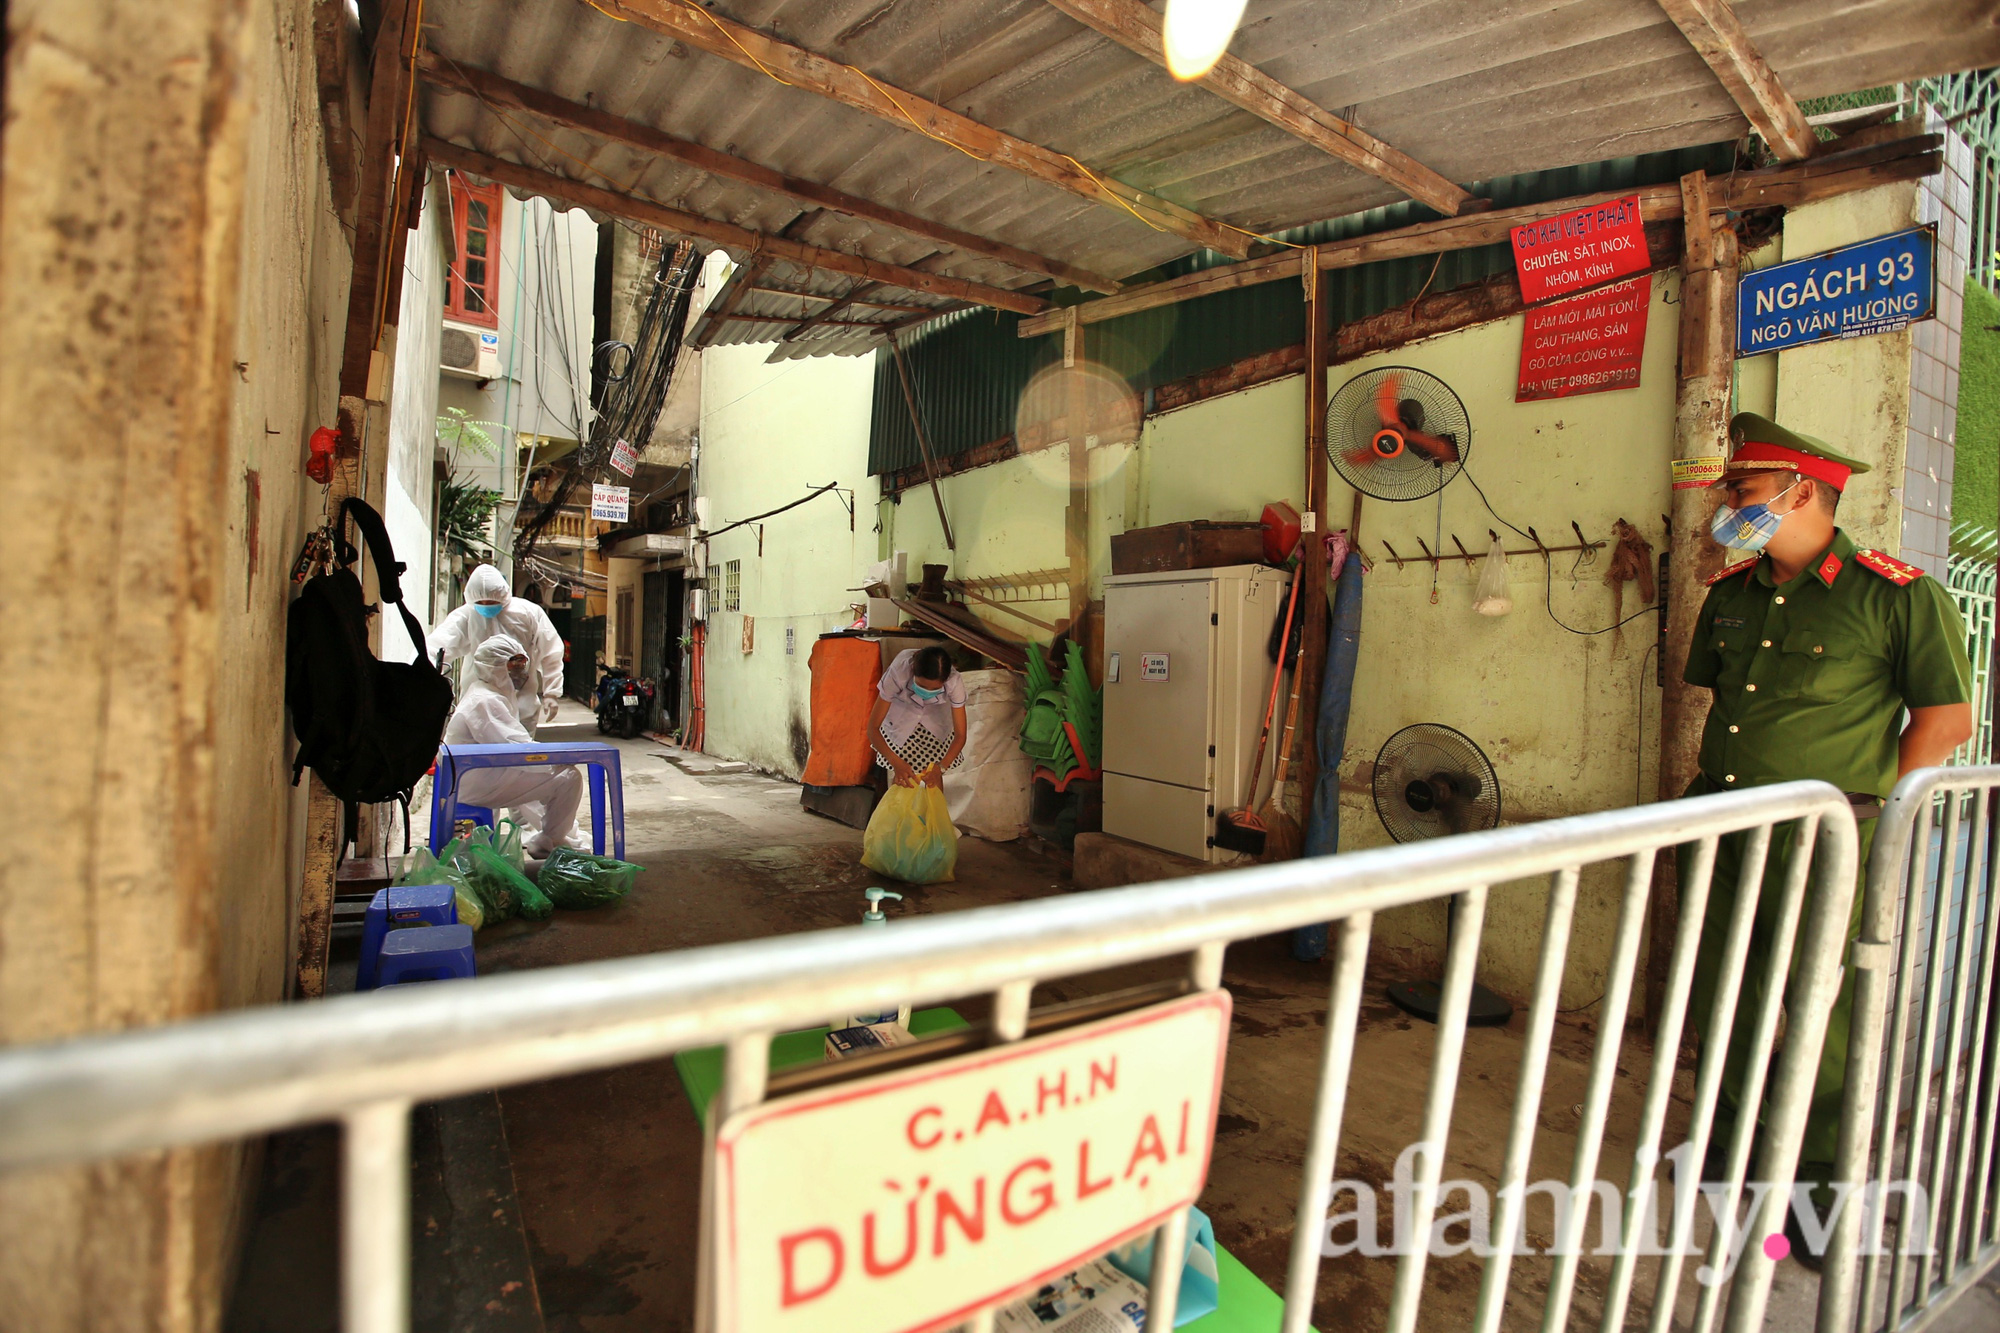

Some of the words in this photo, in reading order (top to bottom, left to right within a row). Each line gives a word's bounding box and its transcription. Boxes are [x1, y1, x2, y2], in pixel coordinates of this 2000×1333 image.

[1517, 226, 1537, 249] CƠ
[1563, 212, 1594, 240] VIỆT
[1523, 249, 1572, 271] CHUYÊN:
[1574, 242, 1599, 260] SẮT,
[1600, 235, 1635, 254] INOX,
[1545, 269, 1583, 287] NHÔM,
[1585, 262, 1614, 279] KÍNH
[1755, 263, 1866, 315] NGÁCH
[1878, 252, 1915, 286] 93
[1534, 314, 1556, 330] LÀM
[1559, 310, 1580, 326] MỚI
[1751, 317, 1792, 344] NGÕ
[1797, 309, 1836, 334] VĂN
[1843, 292, 1918, 324] HƯƠNG
[1560, 328, 1600, 345] THANG,
[1686, 464, 1722, 474] 19006638
[607, 494, 628, 504] QUANG
[905, 1054, 1118, 1151] C.A.H.N
[777, 1157, 1059, 1311] DỪNG
[1076, 1100, 1191, 1202] LẠI
